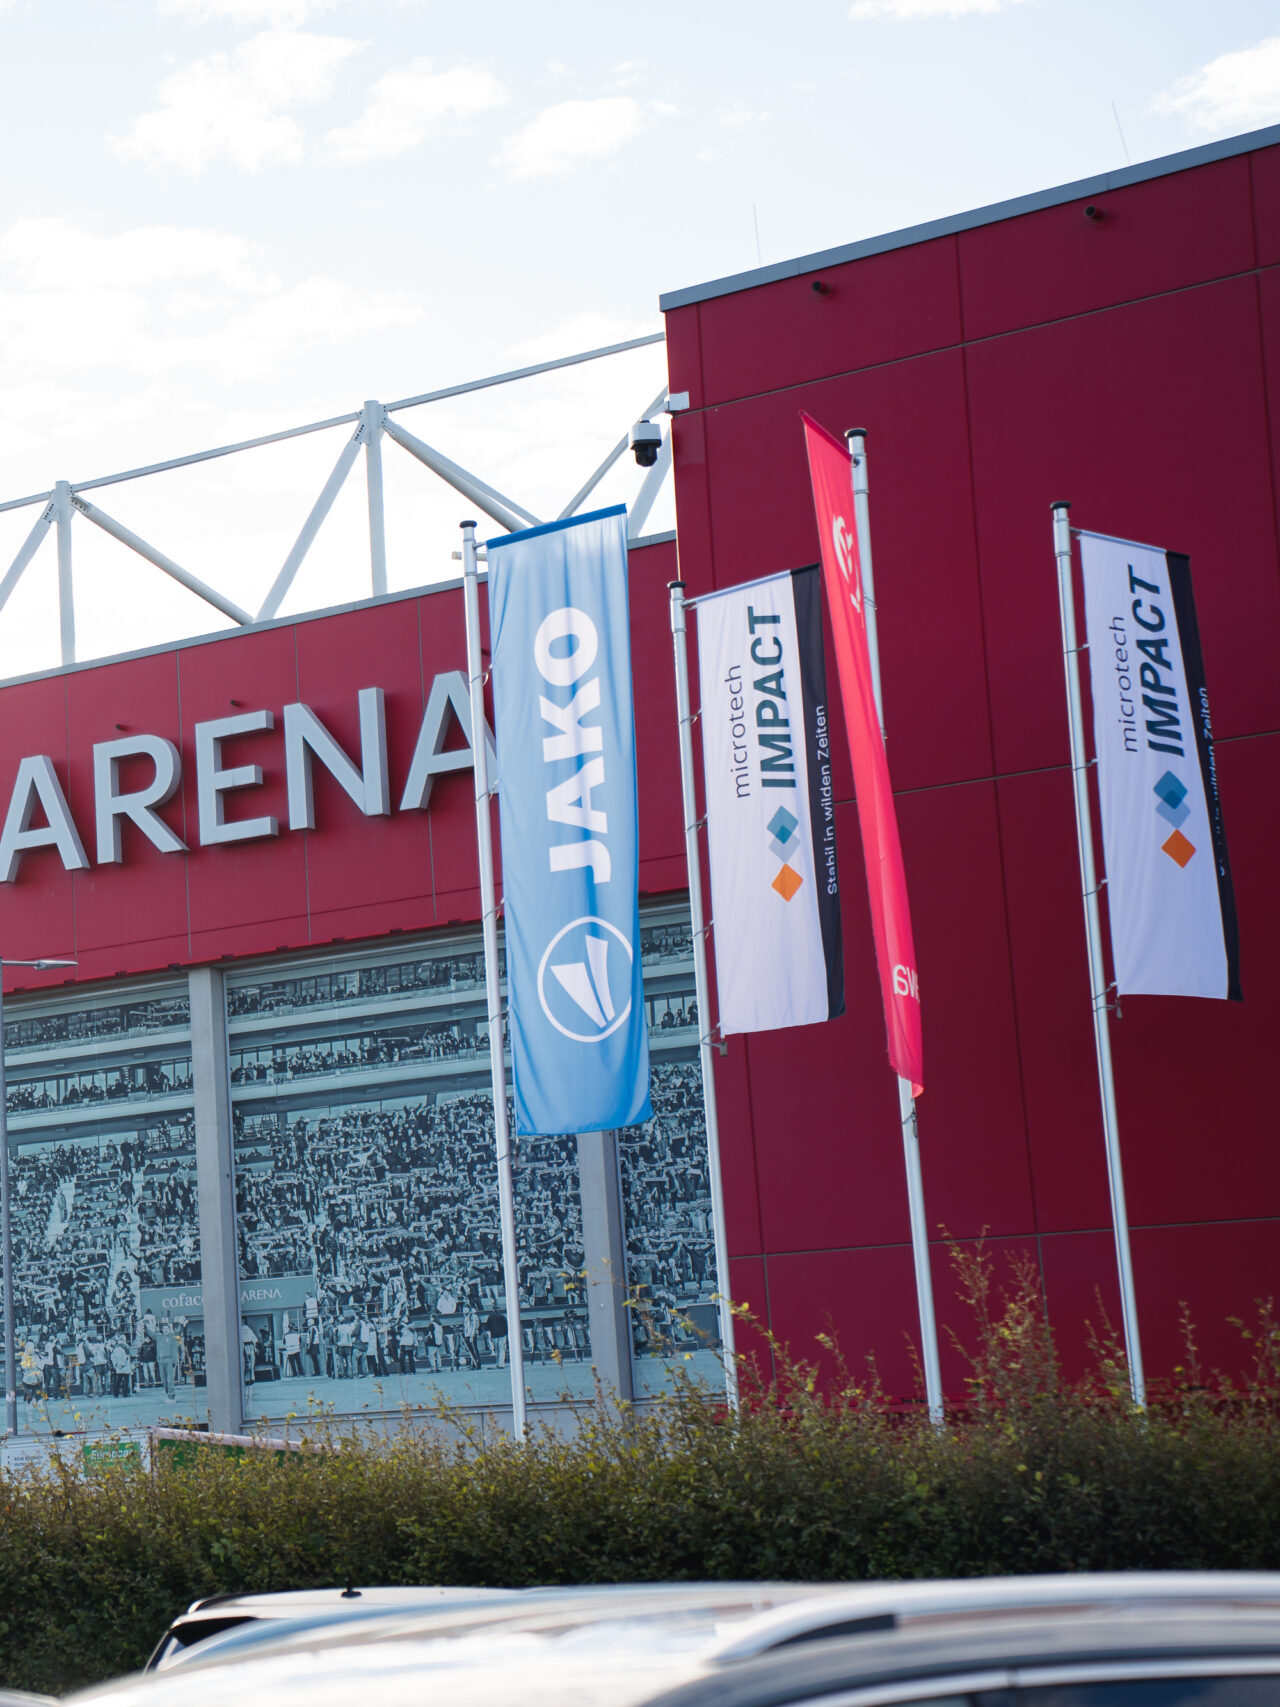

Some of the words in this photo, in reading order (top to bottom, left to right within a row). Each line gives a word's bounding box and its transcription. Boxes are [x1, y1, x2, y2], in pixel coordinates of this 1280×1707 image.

[747, 606, 796, 788] IMPACT
[1109, 616, 1138, 752] microtech
[1128, 564, 1185, 758] IMPACT
[534, 607, 611, 884] JAKO
[725, 665, 750, 798] microtech
[815, 705, 829, 760] Zeiten
[1198, 687, 1213, 740] Zeiten
[820, 765, 833, 821] wilden
[824, 826, 834, 842] in
[162, 1293, 204, 1308] cofac
[240, 1288, 282, 1304] ARENA
